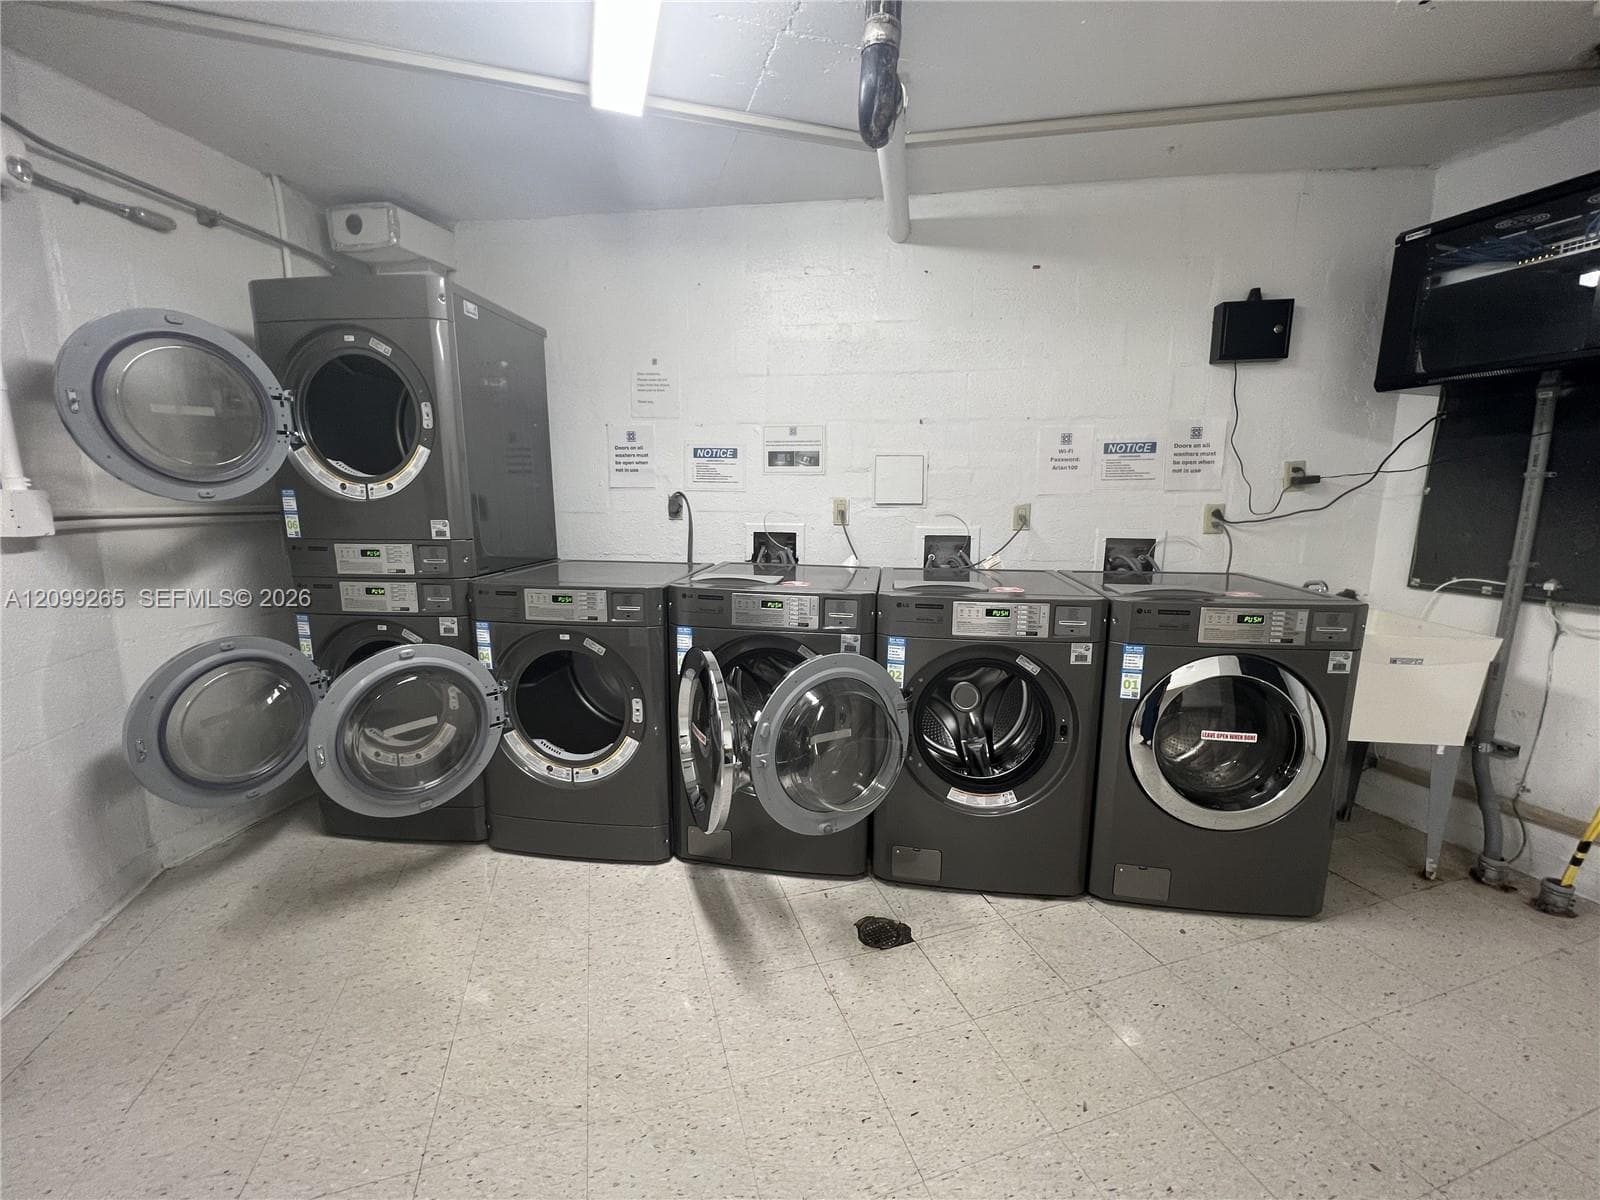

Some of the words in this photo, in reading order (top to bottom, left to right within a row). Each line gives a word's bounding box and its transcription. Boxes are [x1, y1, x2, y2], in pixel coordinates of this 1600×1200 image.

[696, 448, 735, 458] NOTICE
[1107, 443, 1153, 453] NOTICE
[287, 520, 298, 530] 06
[479, 652, 490, 661] 04
[1123, 680, 1139, 690] 01
[1202, 731, 1216, 739] LEAVE
